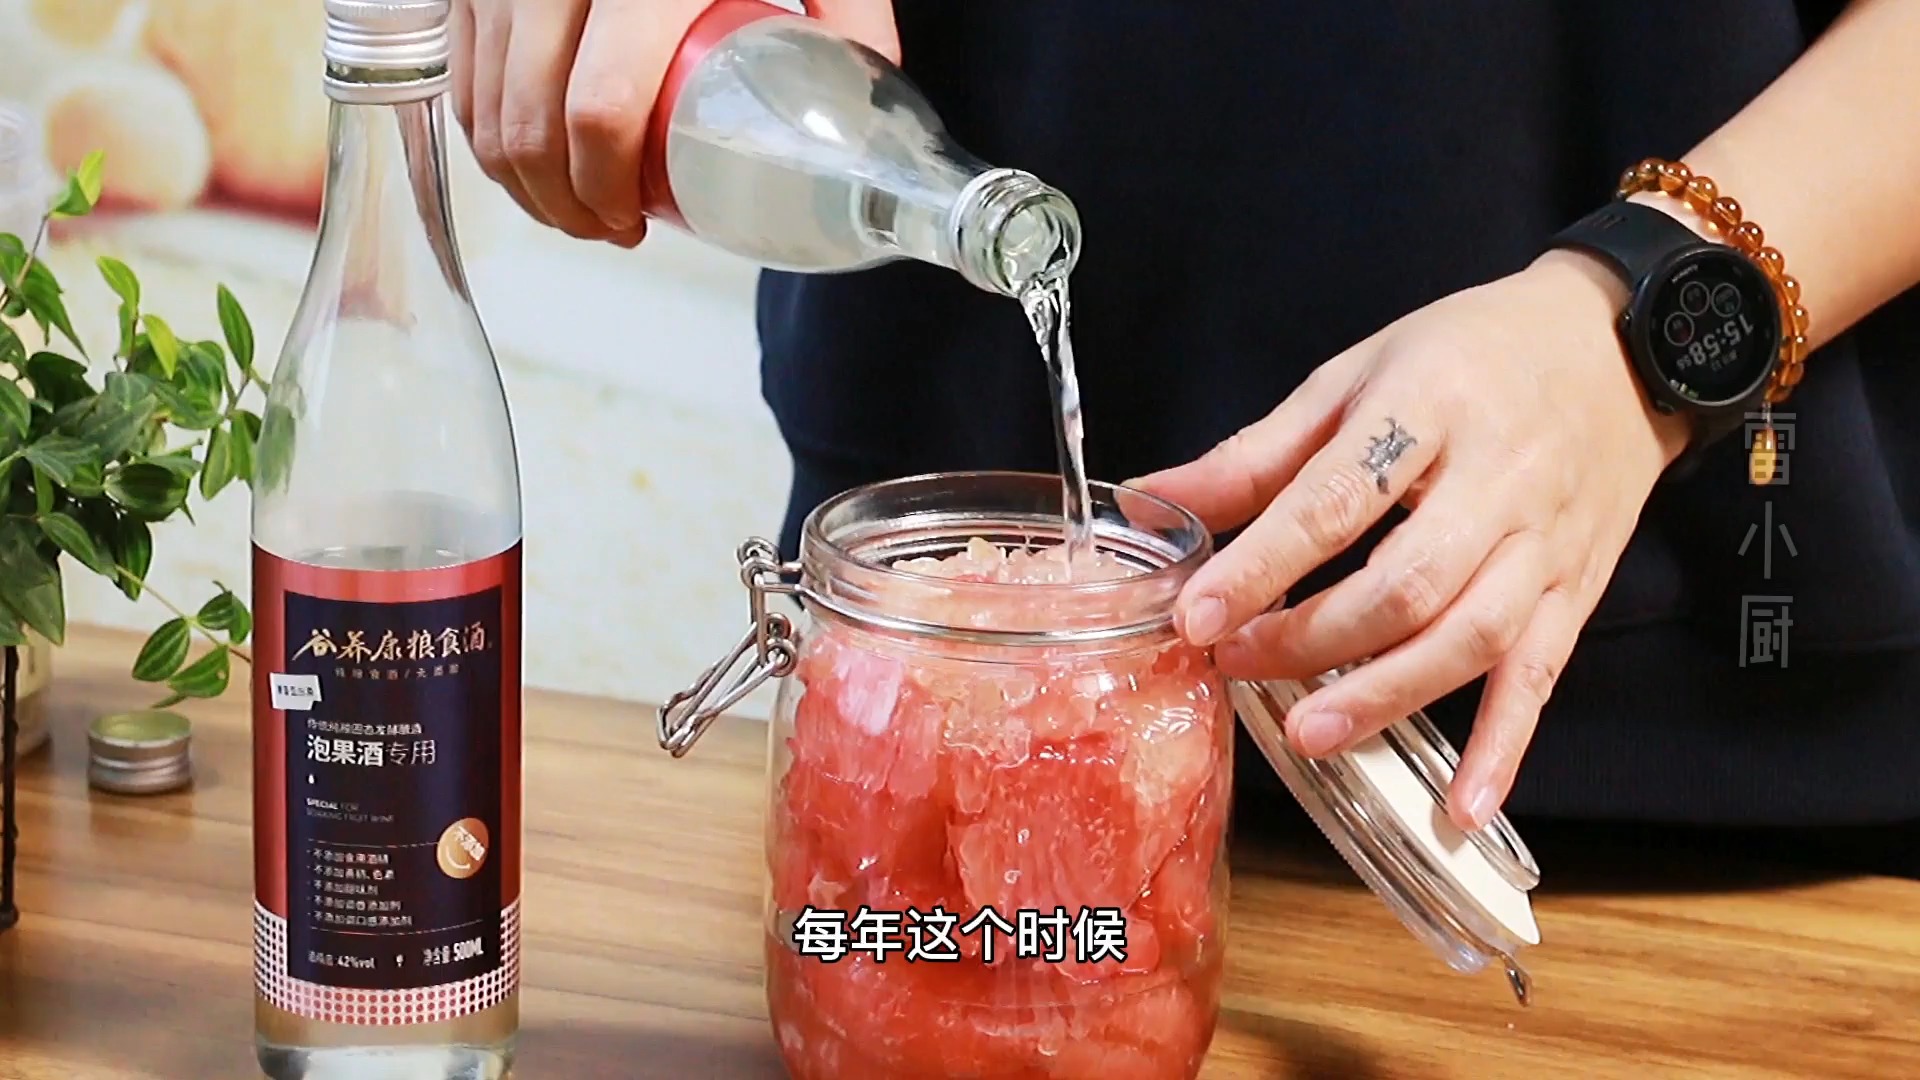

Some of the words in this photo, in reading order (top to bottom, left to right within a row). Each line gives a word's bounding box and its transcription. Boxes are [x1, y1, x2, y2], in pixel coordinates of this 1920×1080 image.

[1689, 313, 1754, 365] 15:58
[306, 734, 437, 767] 泡果酒专用
[306, 798, 338, 809] SPECIAL
